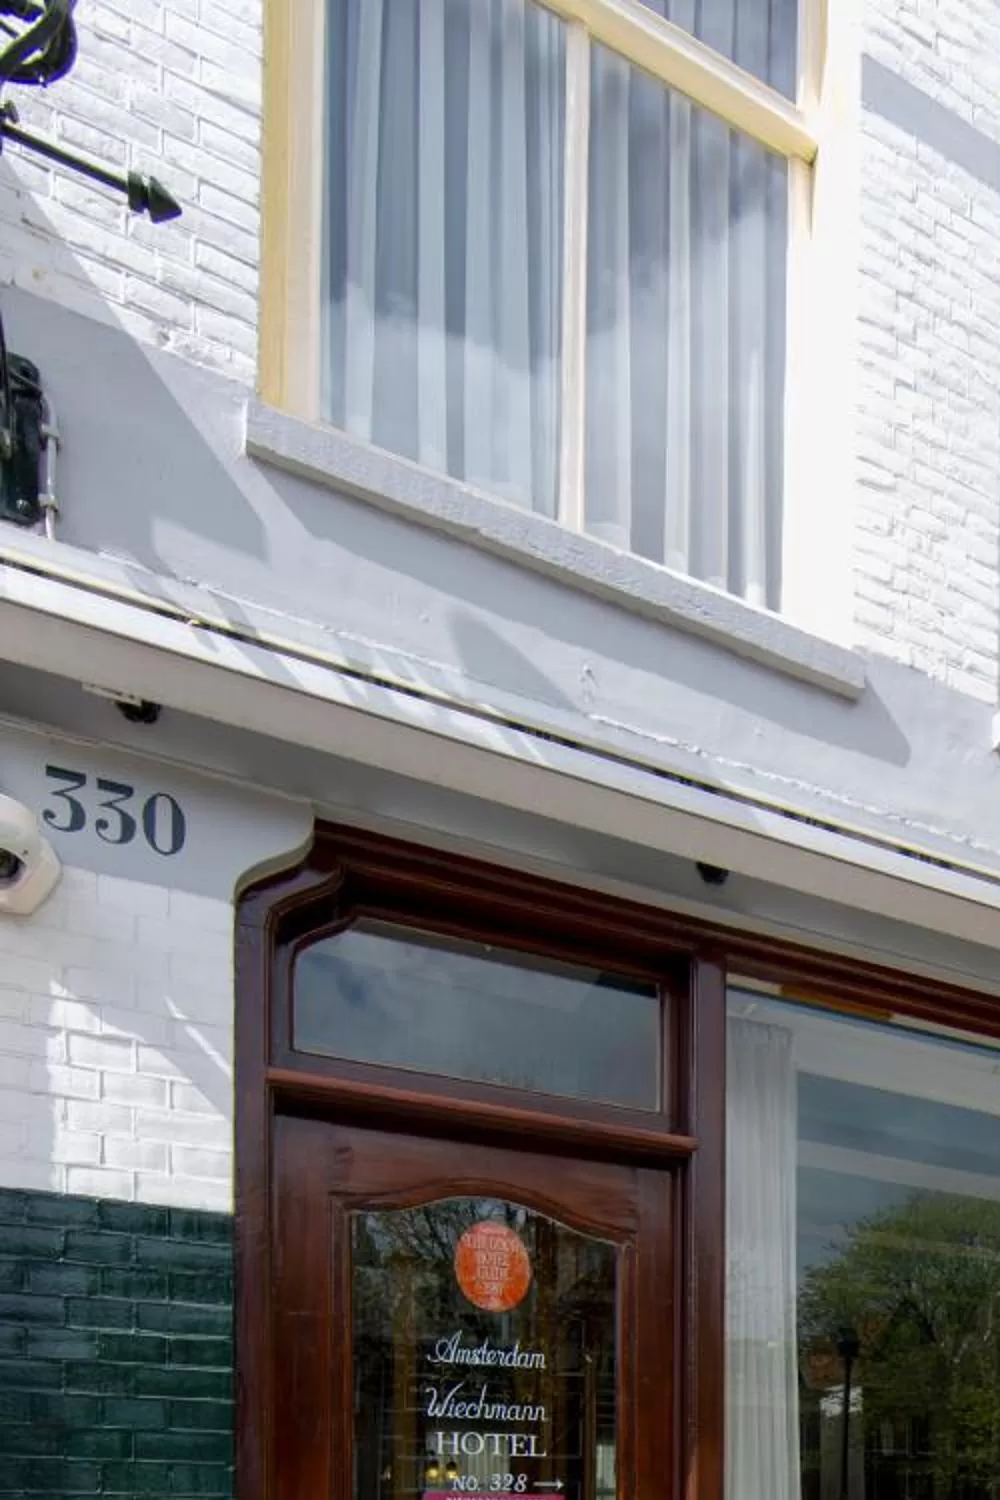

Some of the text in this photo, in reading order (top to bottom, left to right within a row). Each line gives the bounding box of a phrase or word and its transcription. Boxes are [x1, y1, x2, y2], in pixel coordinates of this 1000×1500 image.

[43, 764, 187, 856] 330
[426, 1329, 547, 1369] Amsterdam
[425, 1380, 549, 1422] Wiechmann
[435, 1431, 547, 1457] HOTEL
[489, 1473, 528, 1493] 328
